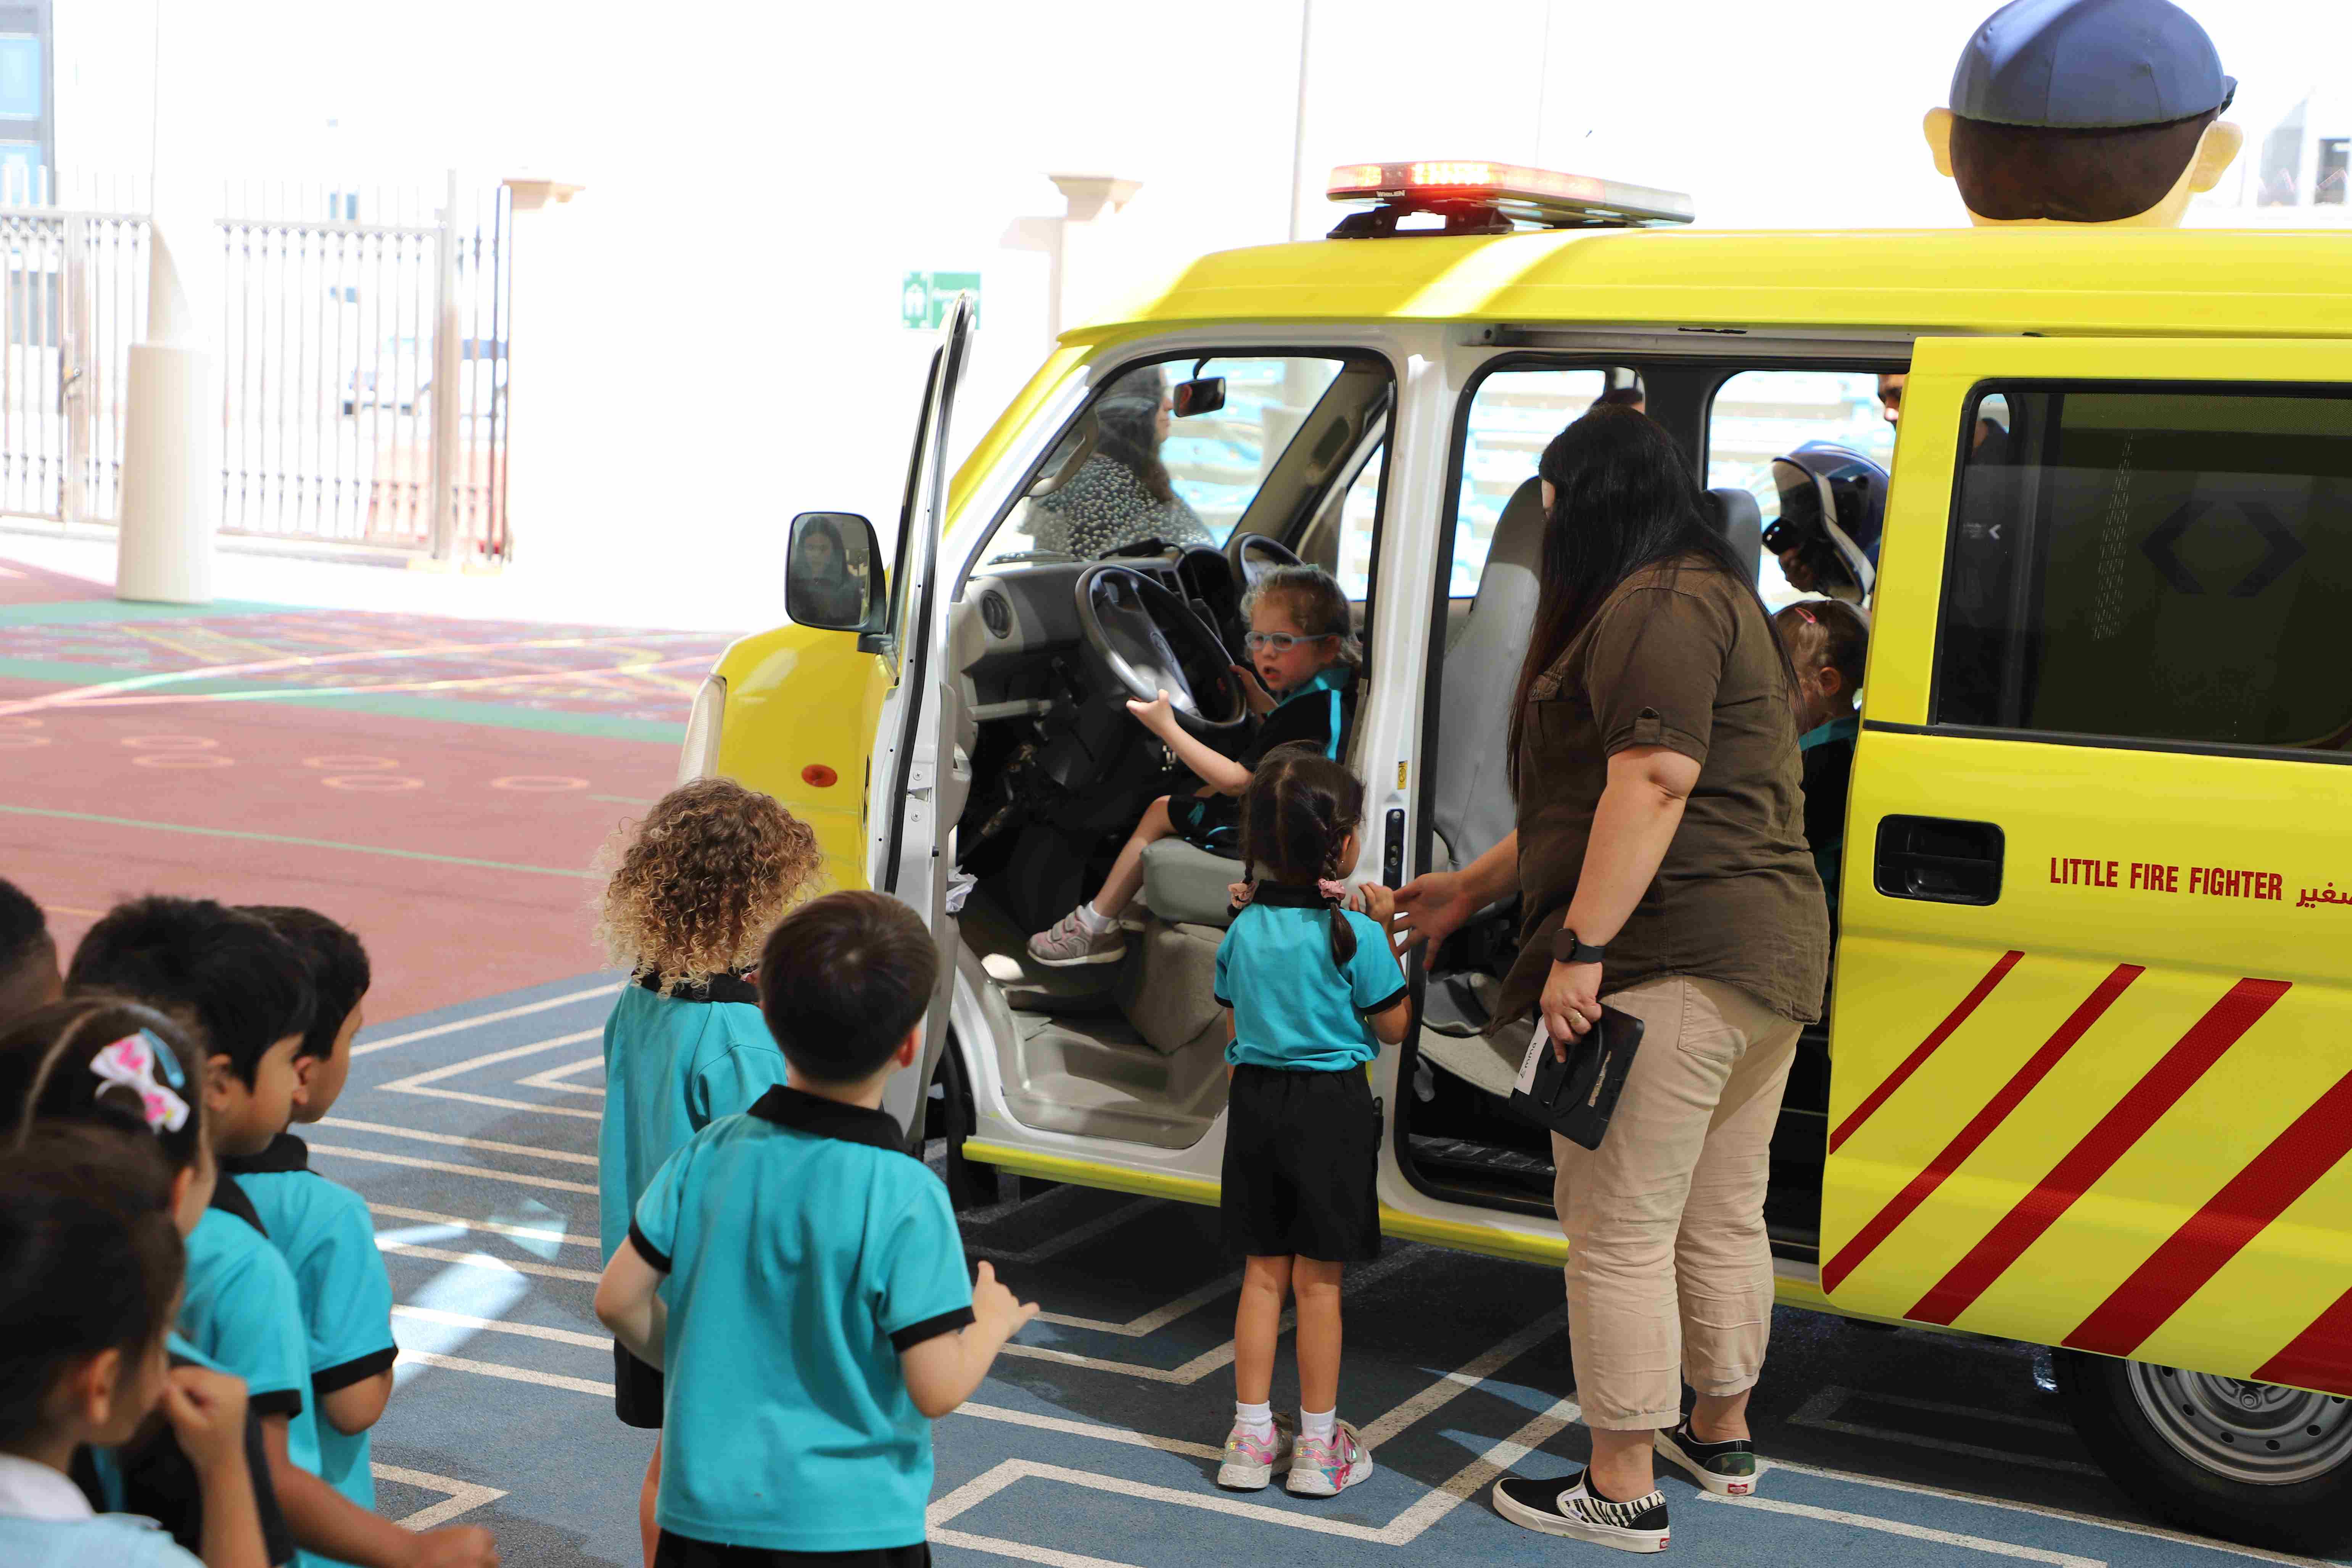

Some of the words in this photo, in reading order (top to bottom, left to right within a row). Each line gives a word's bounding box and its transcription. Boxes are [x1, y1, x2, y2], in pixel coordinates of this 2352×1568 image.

[2050, 857, 2119, 887] LITTLE
[2130, 863, 2179, 893] FIRE
[2189, 867, 2283, 901] FIGHTER
[1520, 1042, 1537, 1079] Emma
